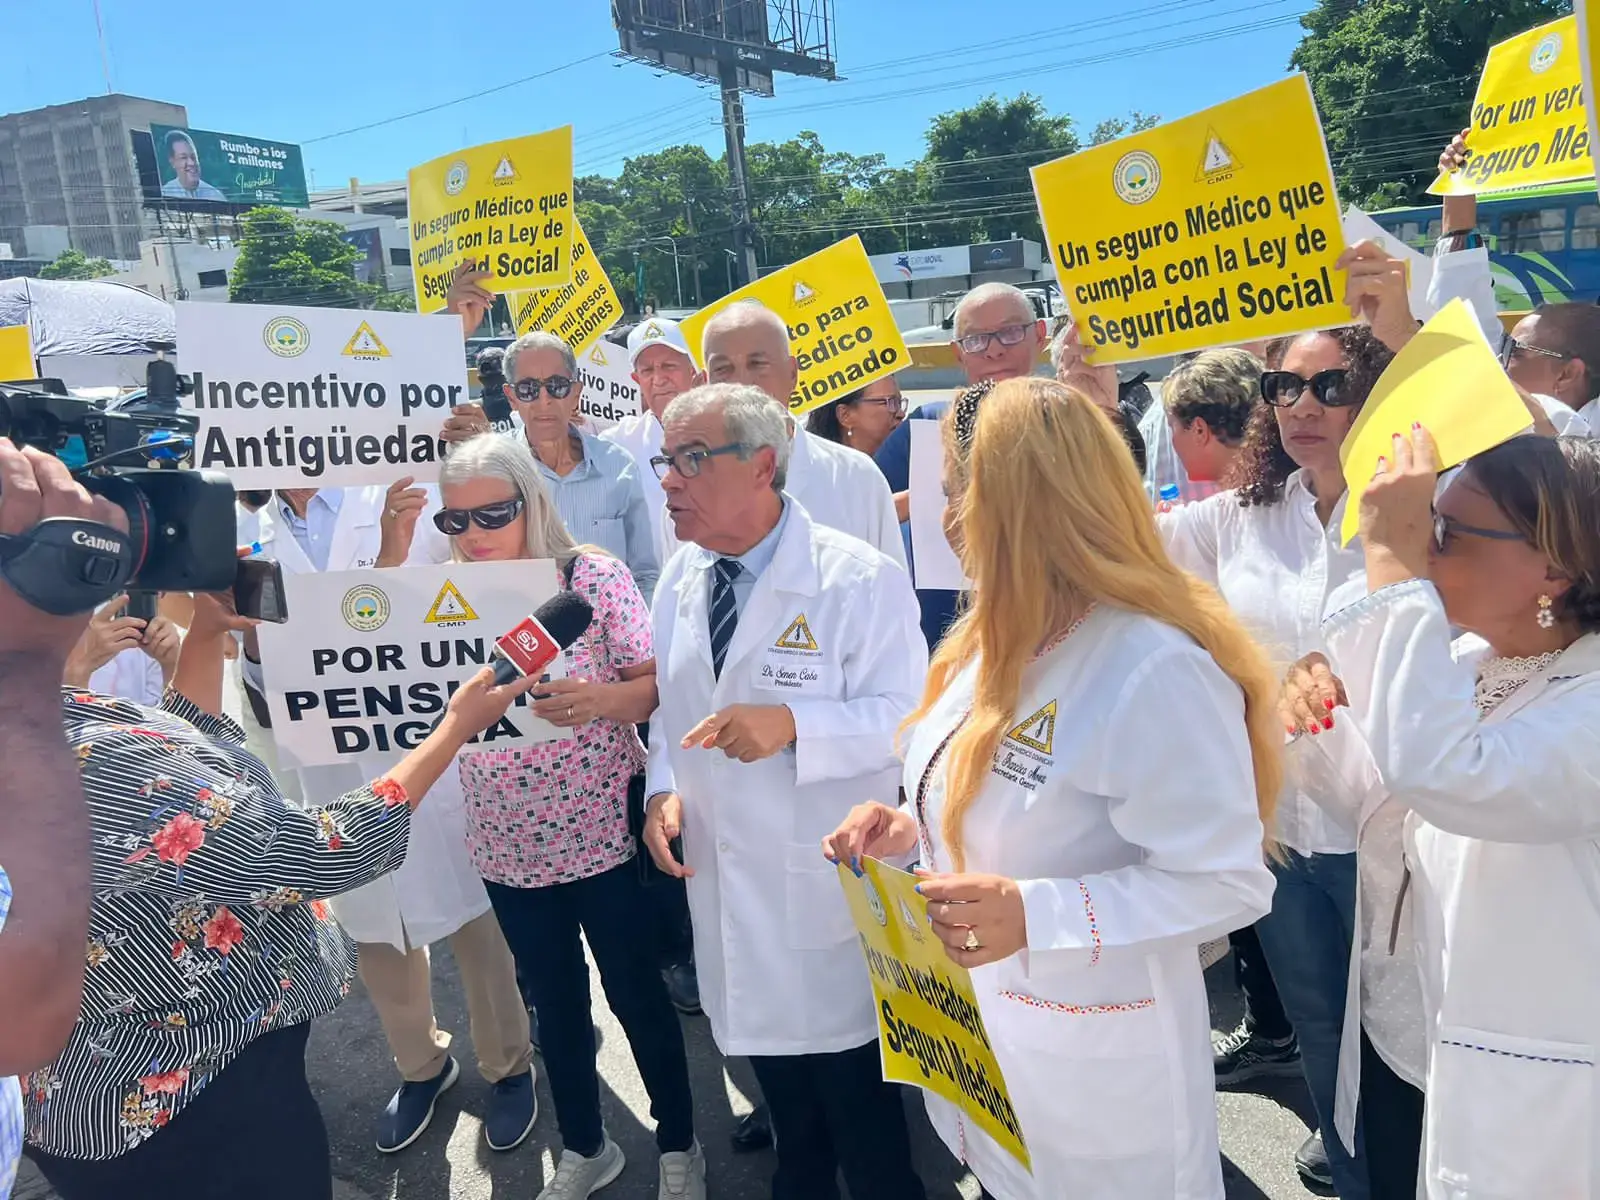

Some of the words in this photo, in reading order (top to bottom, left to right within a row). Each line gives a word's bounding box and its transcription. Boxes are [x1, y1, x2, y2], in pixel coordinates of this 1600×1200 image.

[1508, 95, 1537, 124] un
[219, 139, 260, 156] Rumbo
[262, 149, 269, 157] a
[270, 146, 288, 160] los
[227, 153, 236, 164] 2
[237, 154, 284, 170] millones
[1206, 173, 1234, 185] CMD
[413, 221, 427, 241] Un
[430, 207, 470, 234] seguro
[475, 195, 534, 219] Médico
[539, 191, 568, 215] que
[1058, 240, 1090, 270] Un
[1096, 220, 1179, 262] seguro
[1185, 194, 1272, 238] Médico
[1279, 181, 1325, 221] que
[418, 237, 454, 267] cumpla
[457, 231, 482, 250] con
[487, 224, 503, 245] la
[509, 223, 538, 246] Ley
[543, 218, 563, 239] de
[497, 246, 560, 278] Social
[1075, 264, 1157, 305] cumpla
[1164, 255, 1210, 285] con
[1214, 244, 1239, 274] la
[1243, 235, 1287, 269] Ley
[1295, 223, 1328, 256] de
[575, 267, 590, 288] de
[559, 311, 577, 334] mil
[575, 283, 607, 321] pesos
[566, 299, 614, 349] nsiones
[786, 321, 811, 342] to
[815, 294, 870, 332] para
[1088, 287, 1230, 349] Seguridad
[1236, 266, 1334, 319] Social
[796, 325, 873, 372] édico
[192, 371, 387, 410] Incentivo
[400, 383, 463, 417] por
[576, 367, 605, 391] tivo
[610, 381, 637, 401] por
[789, 346, 897, 409] sionado
[71, 530, 121, 554] Canon
[312, 643, 407, 676] POR
[331, 715, 524, 754] DIGA
[859, 932, 889, 984] Por
[885, 956, 913, 995] un
[906, 962, 991, 1051] verdadero
[881, 998, 956, 1080] Seguro
